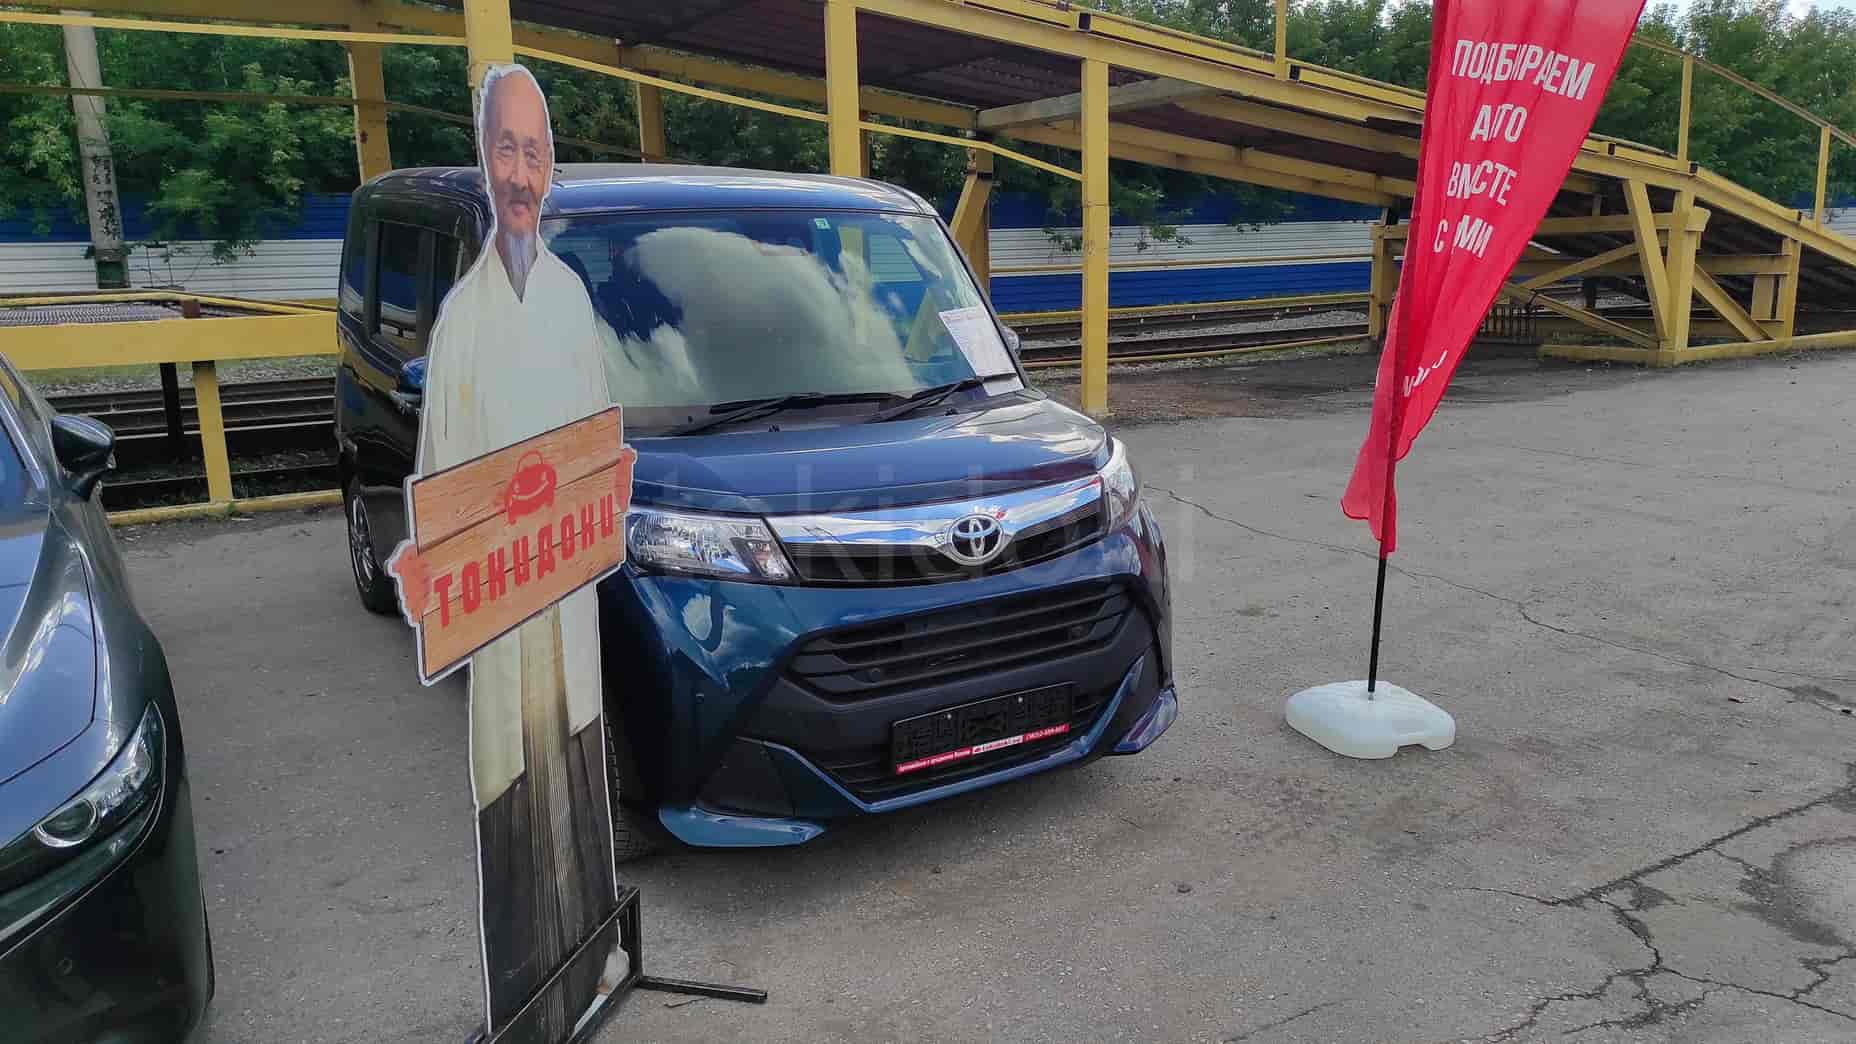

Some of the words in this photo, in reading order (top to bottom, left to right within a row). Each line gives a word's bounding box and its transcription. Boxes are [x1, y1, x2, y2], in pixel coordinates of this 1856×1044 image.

[1470, 103, 1528, 143] АТО
[1433, 219, 1449, 253] С
[434, 492, 614, 628] ТОКИДОКИ
